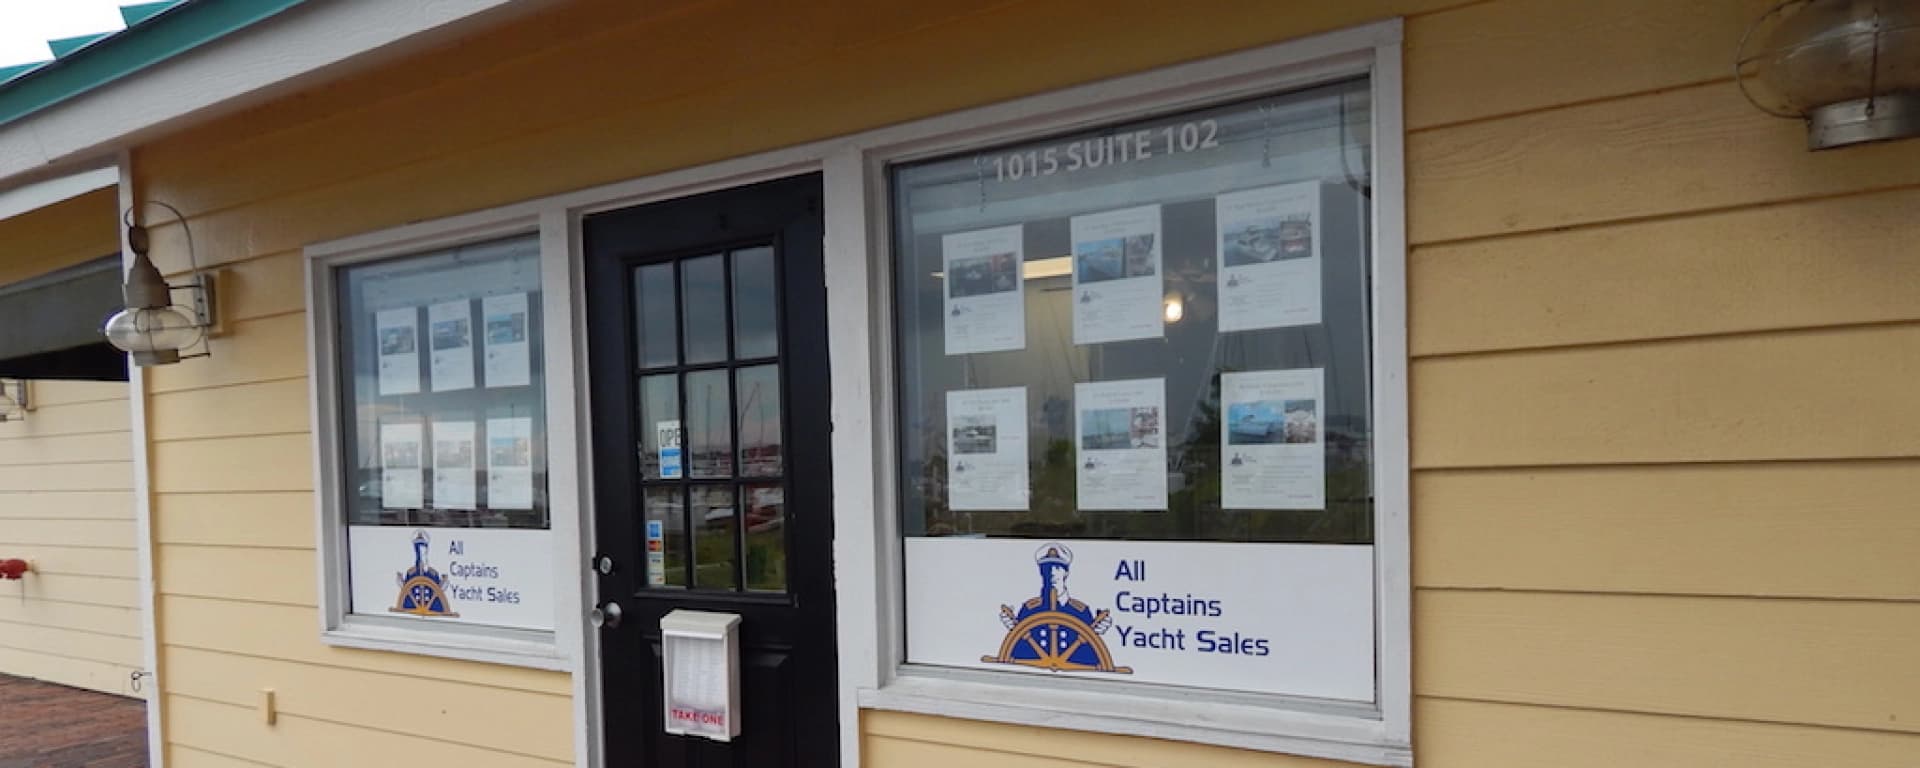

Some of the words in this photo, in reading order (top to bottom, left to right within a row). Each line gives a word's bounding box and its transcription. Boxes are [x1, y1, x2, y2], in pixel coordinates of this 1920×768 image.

[992, 147, 1058, 183] 1015
[1066, 129, 1153, 172] SUITE
[1161, 118, 1220, 154] 102
[449, 540, 464, 555] All
[449, 560, 499, 580] Captains
[1114, 559, 1145, 581] All
[451, 583, 483, 601] Yacht
[486, 587, 521, 604] Sales
[1115, 590, 1222, 618] Captains
[1115, 625, 1186, 650] Yacht
[1196, 630, 1270, 656] Sales
[671, 708, 697, 721] TAKE
[703, 711, 726, 726] ONE
